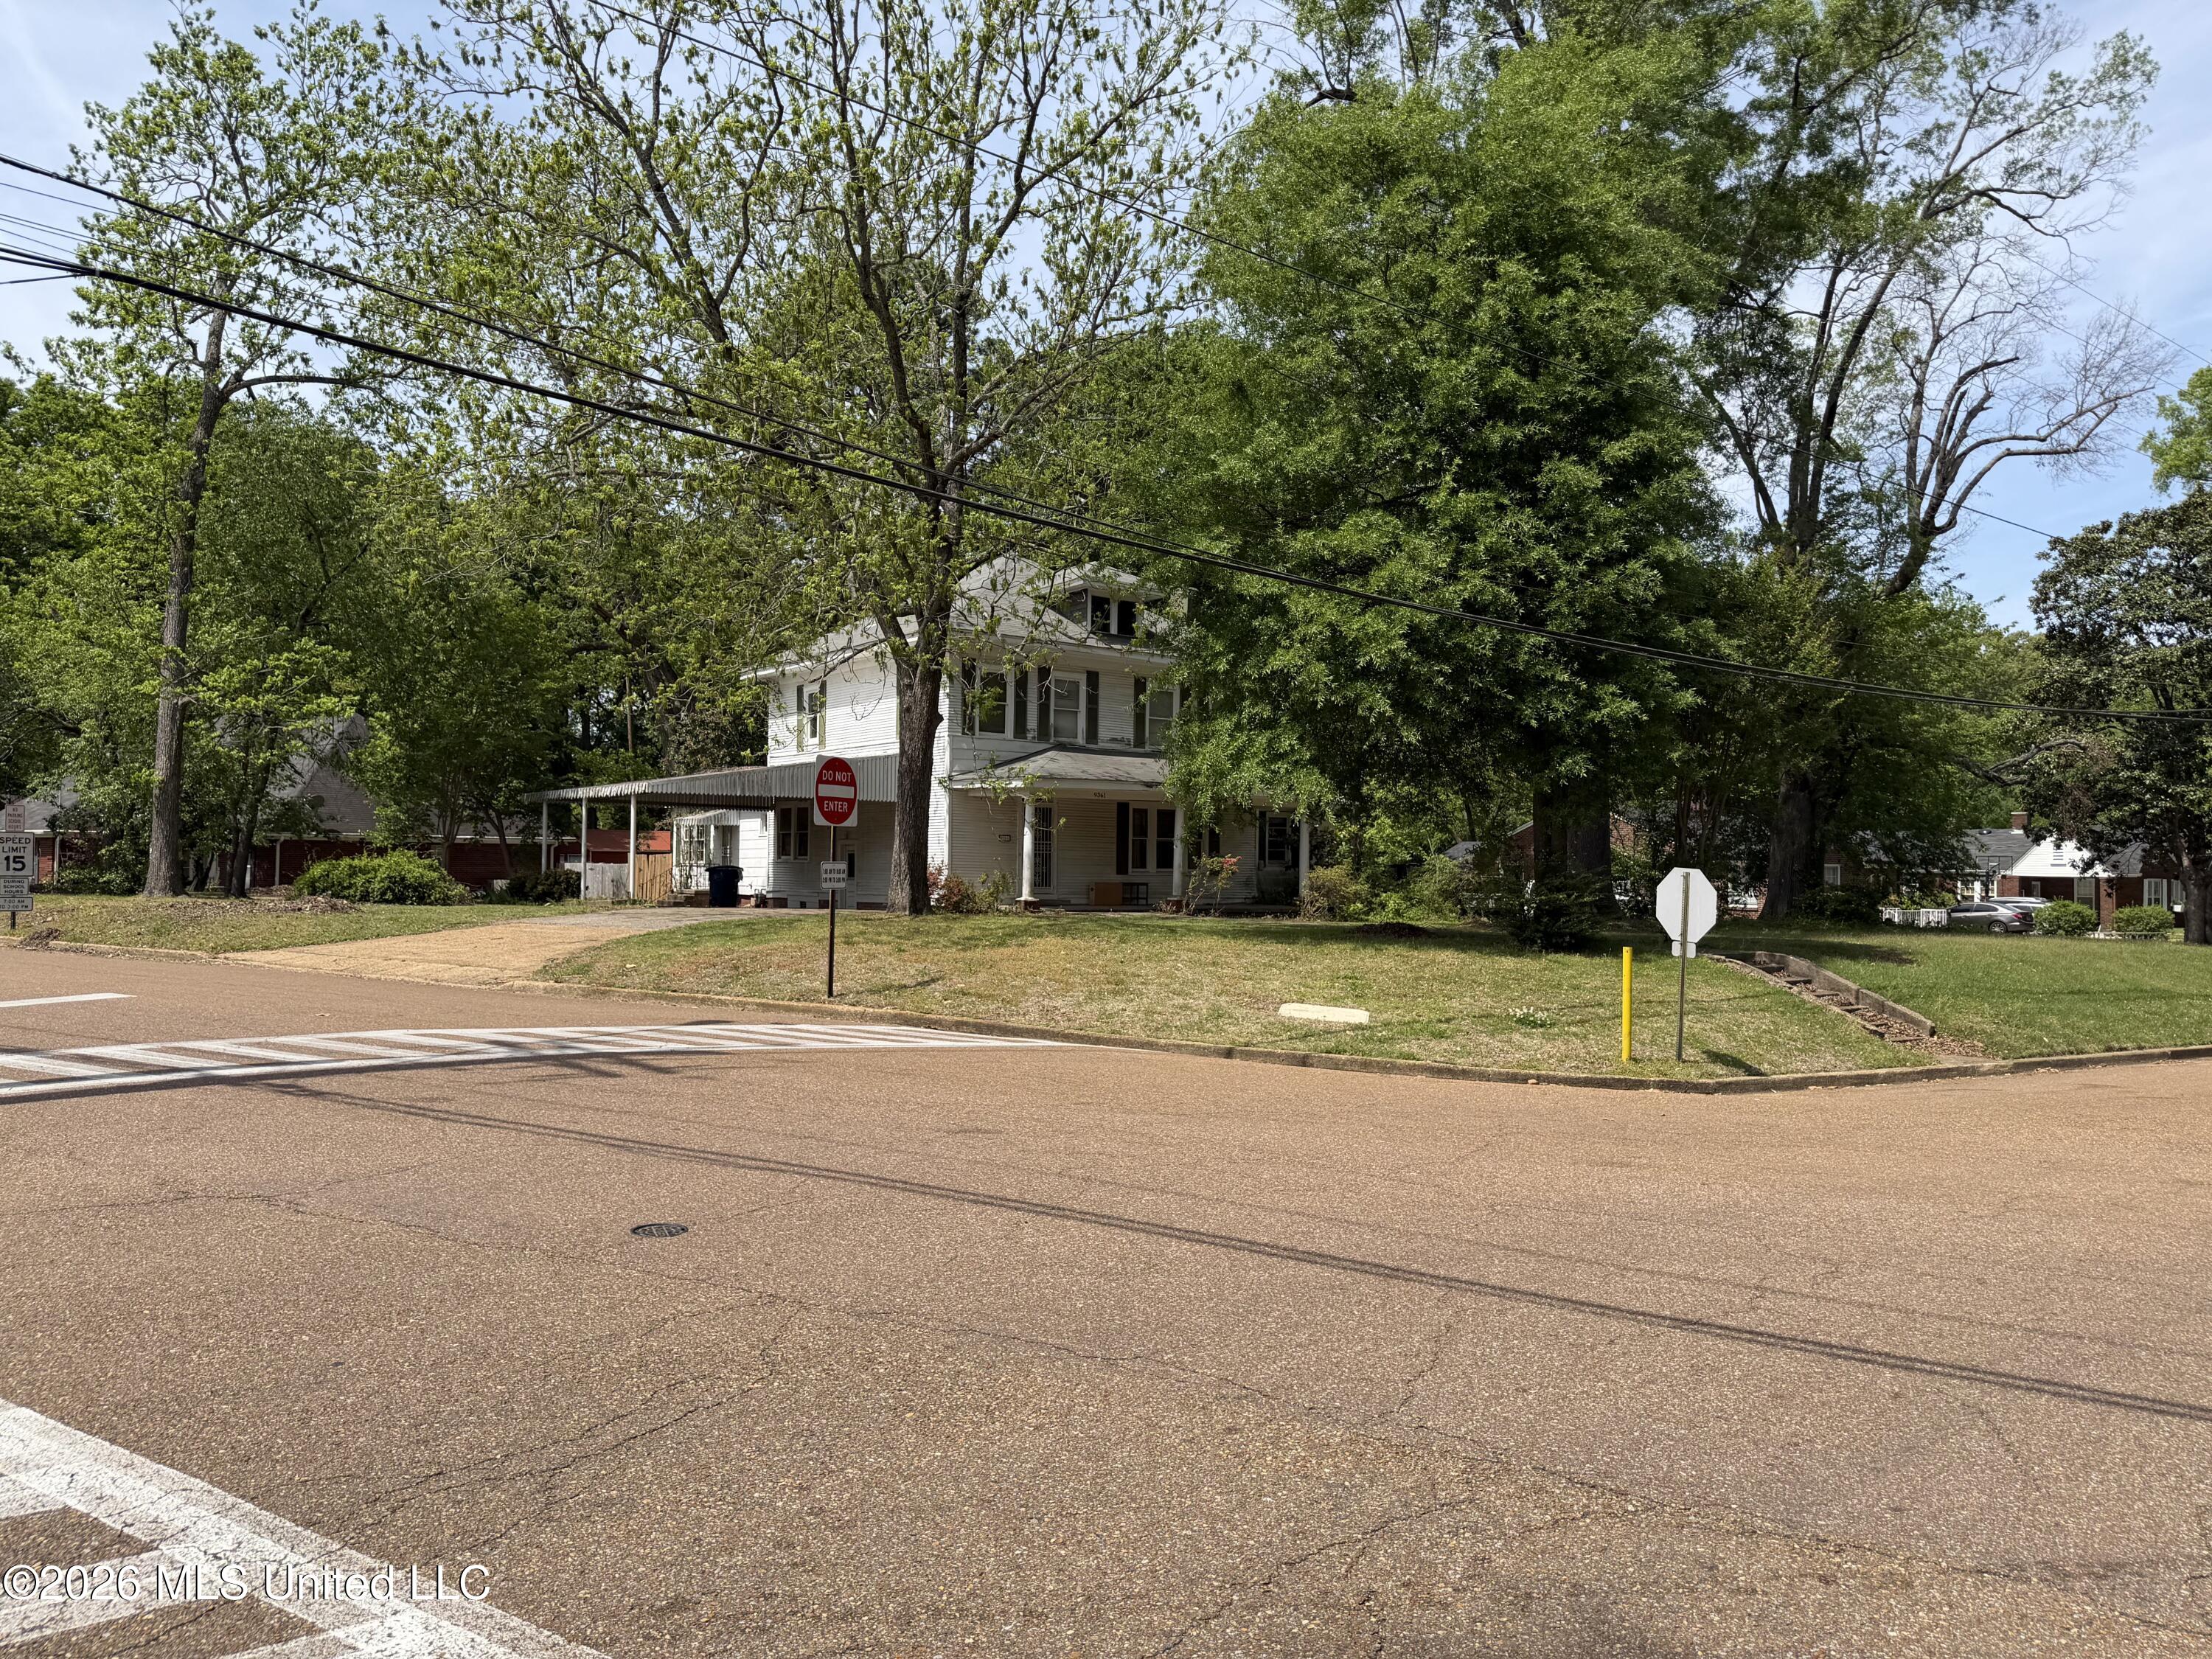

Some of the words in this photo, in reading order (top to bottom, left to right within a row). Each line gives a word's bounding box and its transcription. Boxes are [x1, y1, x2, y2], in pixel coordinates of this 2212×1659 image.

[822, 770, 833, 781] DO
[835, 771, 852, 782] NOT
[824, 801, 848, 813] ENTER
[4, 855, 26, 872] 15
